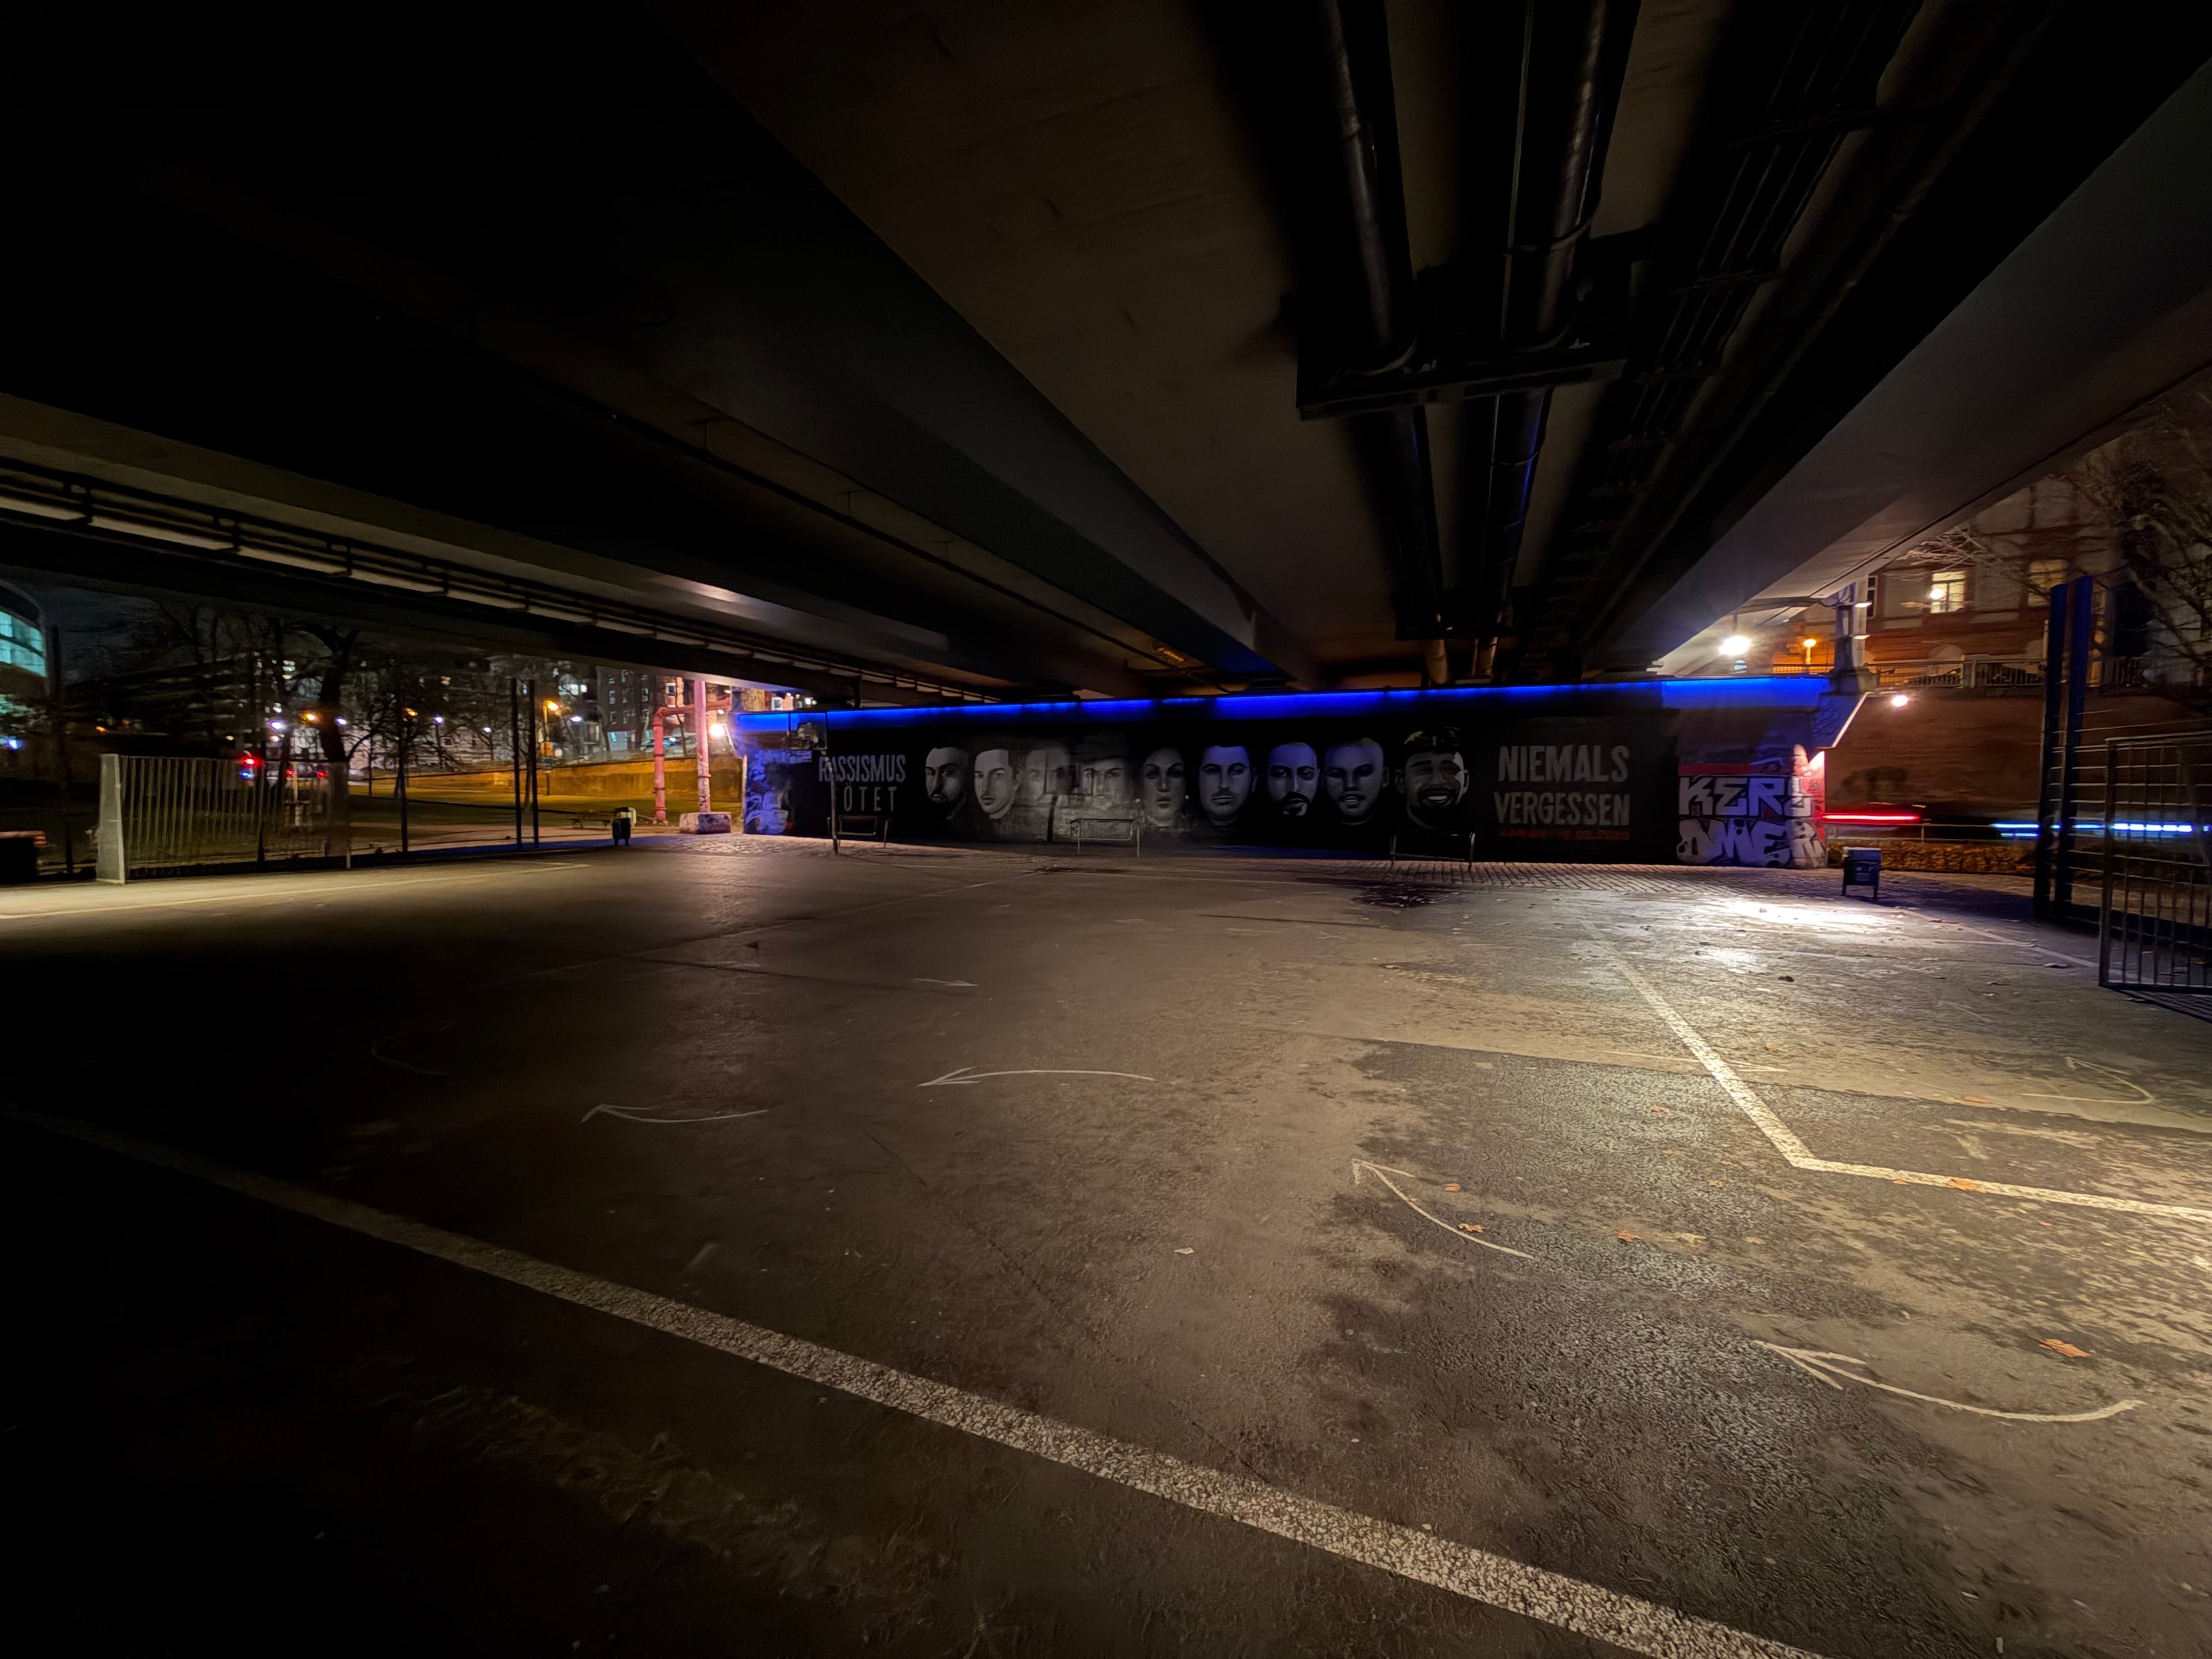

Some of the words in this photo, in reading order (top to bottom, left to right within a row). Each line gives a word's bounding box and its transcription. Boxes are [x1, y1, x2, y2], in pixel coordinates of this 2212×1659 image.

[1498, 744, 1630, 782] NIEMALS
[830, 782, 897, 812] ÖTET
[1494, 791, 1631, 826] VERGESSEN
